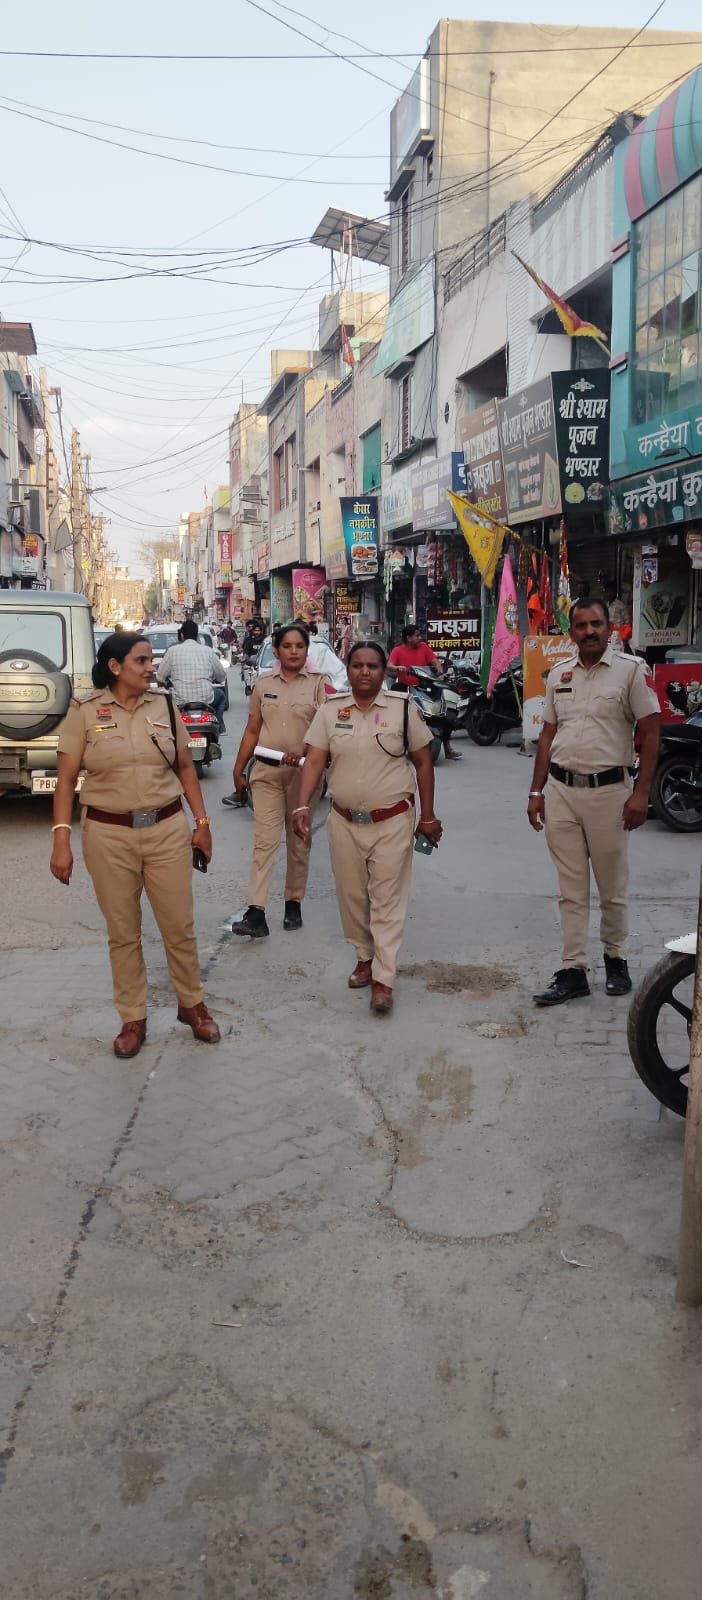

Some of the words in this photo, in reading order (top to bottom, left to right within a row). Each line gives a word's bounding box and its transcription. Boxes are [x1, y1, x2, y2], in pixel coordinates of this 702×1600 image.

[559, 391, 577, 419] श्री
[577, 398, 608, 419] श्याम
[568, 425, 599, 455] पूजन
[637, 420, 690, 457] कन्हैया
[565, 456, 602, 478] भण्डार
[427, 619, 479, 638] जसूजा
[462, 637, 481, 648] स्टोर
